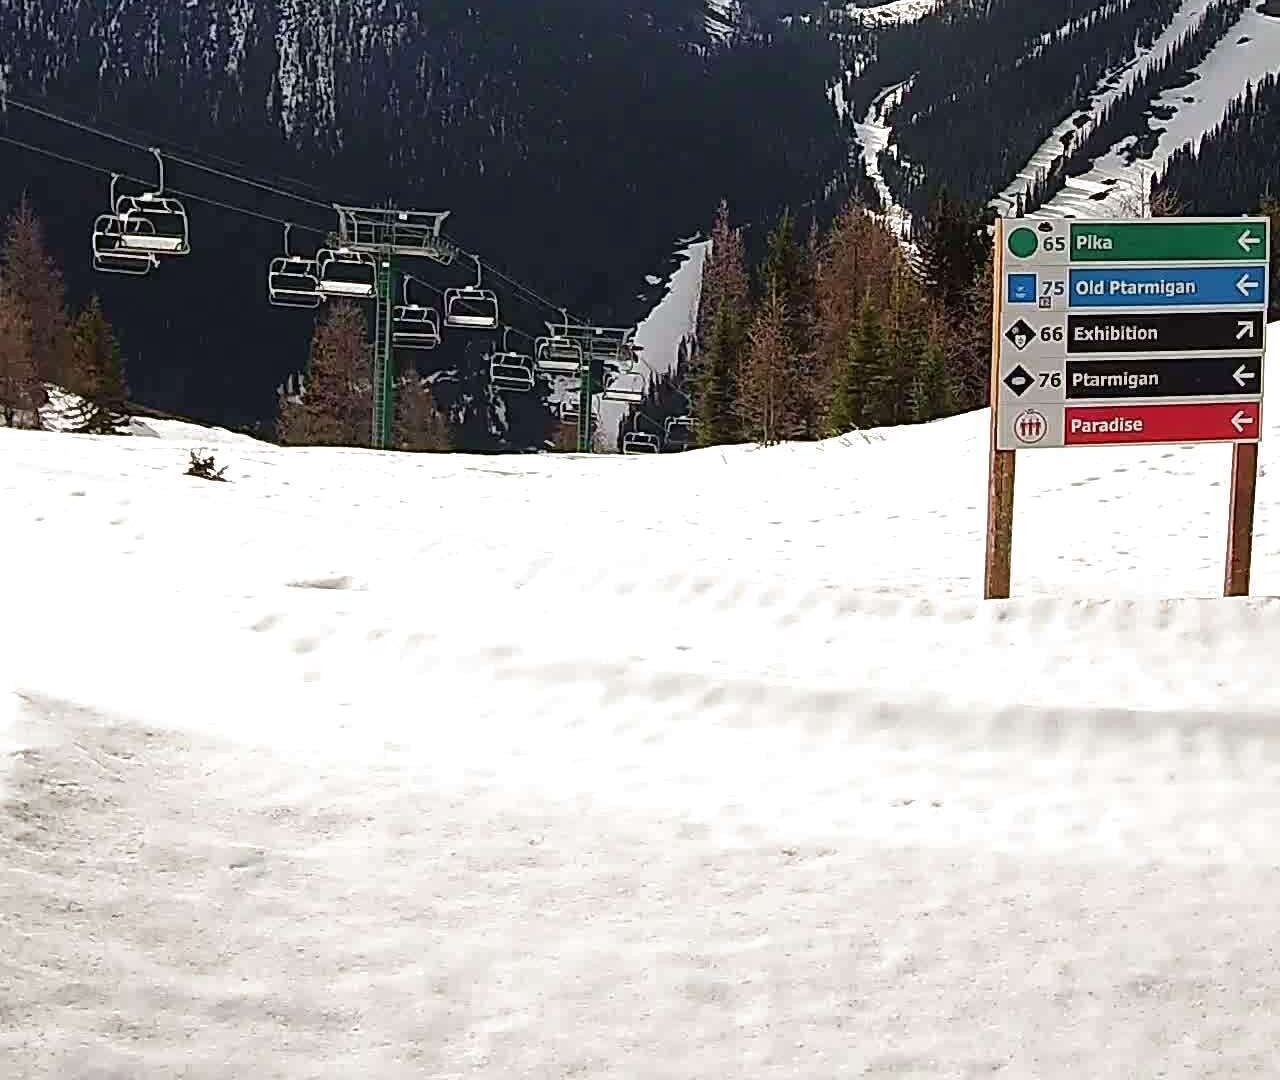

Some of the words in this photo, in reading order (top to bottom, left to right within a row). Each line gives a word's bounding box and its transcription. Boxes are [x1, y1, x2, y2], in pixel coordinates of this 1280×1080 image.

[1043, 236, 1066, 252] 65
[1076, 234, 1113, 251] Pika
[1041, 281, 1065, 296] 75
[1075, 280, 1105, 295] Old
[1109, 280, 1197, 298] Ptarmigan
[1040, 326, 1063, 342] 66
[1073, 325, 1158, 342] Exhibition
[1038, 372, 1062, 388] 76
[1072, 371, 1159, 389] Ptarmigan
[1070, 417, 1143, 433] Paradise
